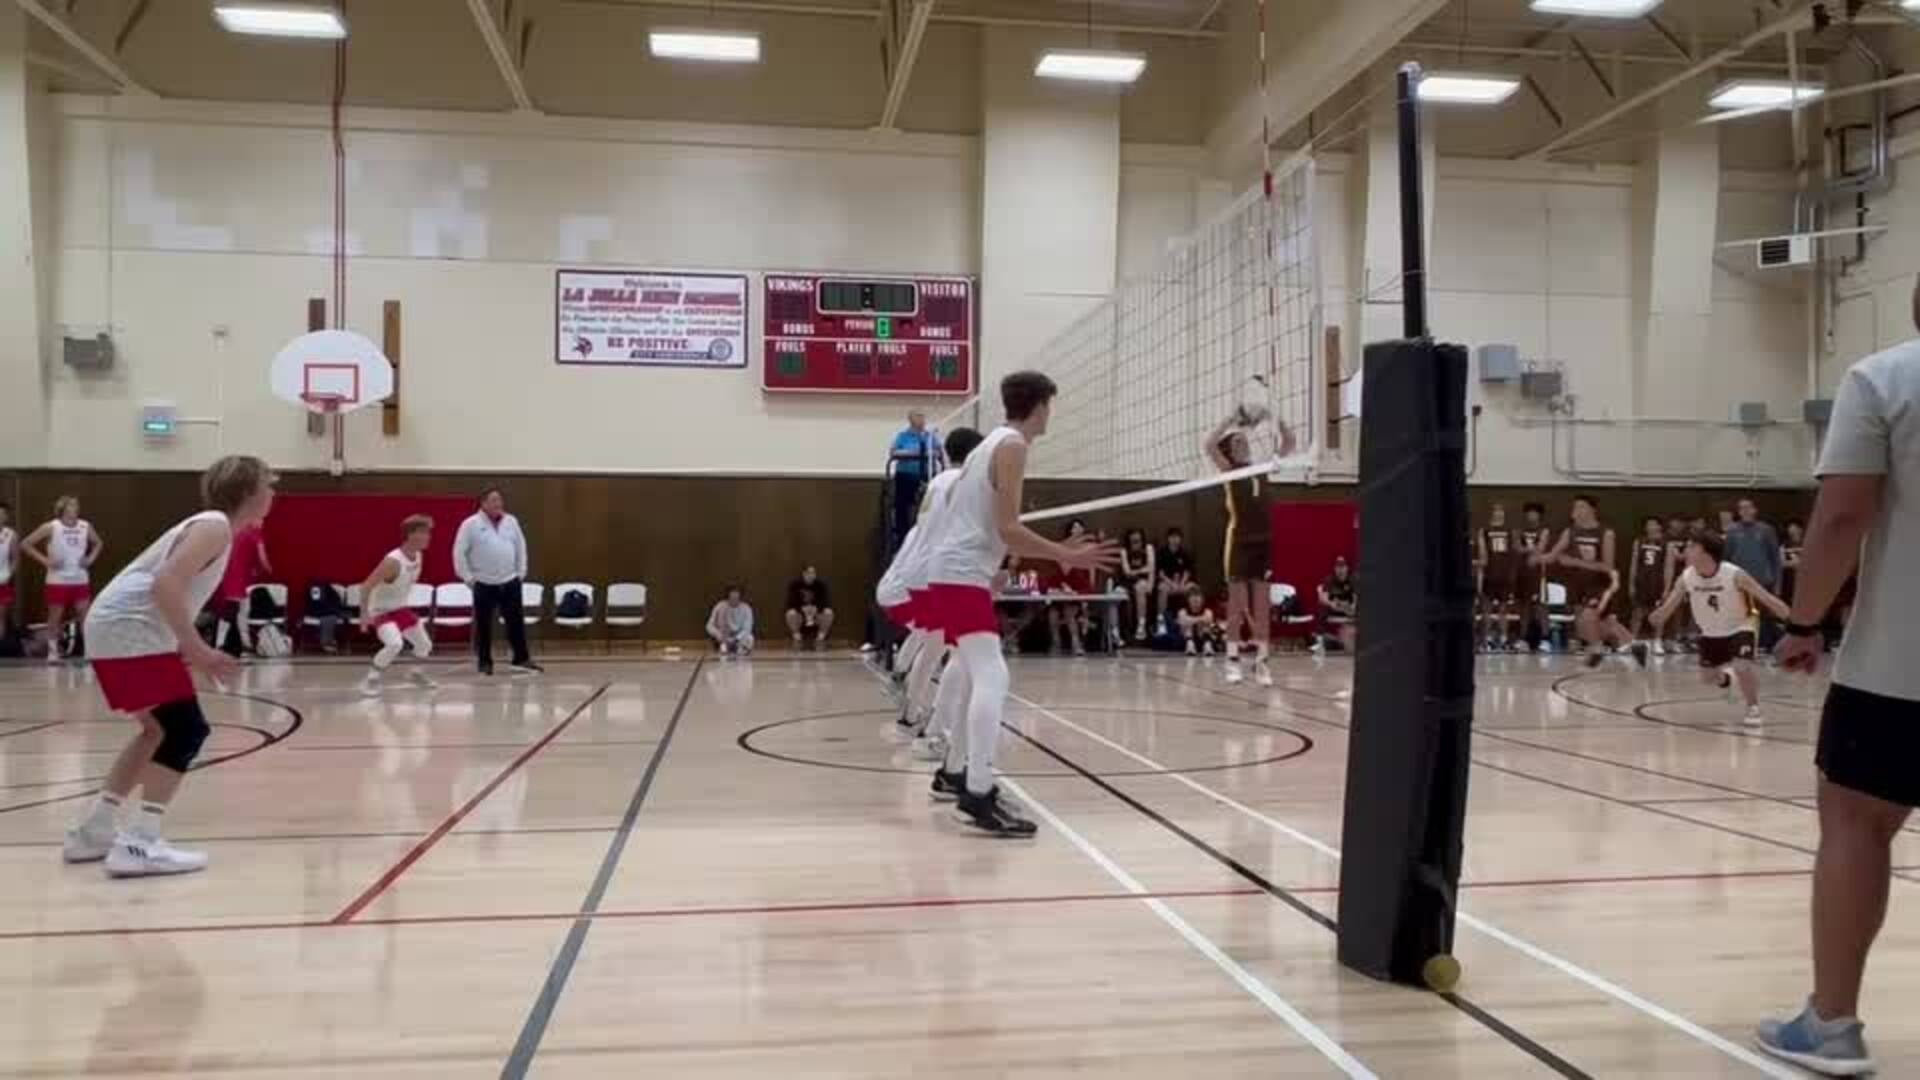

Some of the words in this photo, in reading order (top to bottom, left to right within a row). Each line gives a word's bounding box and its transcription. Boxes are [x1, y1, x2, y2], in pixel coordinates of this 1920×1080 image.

[767, 278, 815, 292] VIKINGS
[920, 282, 966, 297] VISITOR
[562, 287, 585, 303] LA
[782, 322, 815, 335] BONUS
[919, 325, 952, 338] BONUS
[628, 337, 689, 350] POSITIVE
[835, 342, 873, 354] PLAYER
